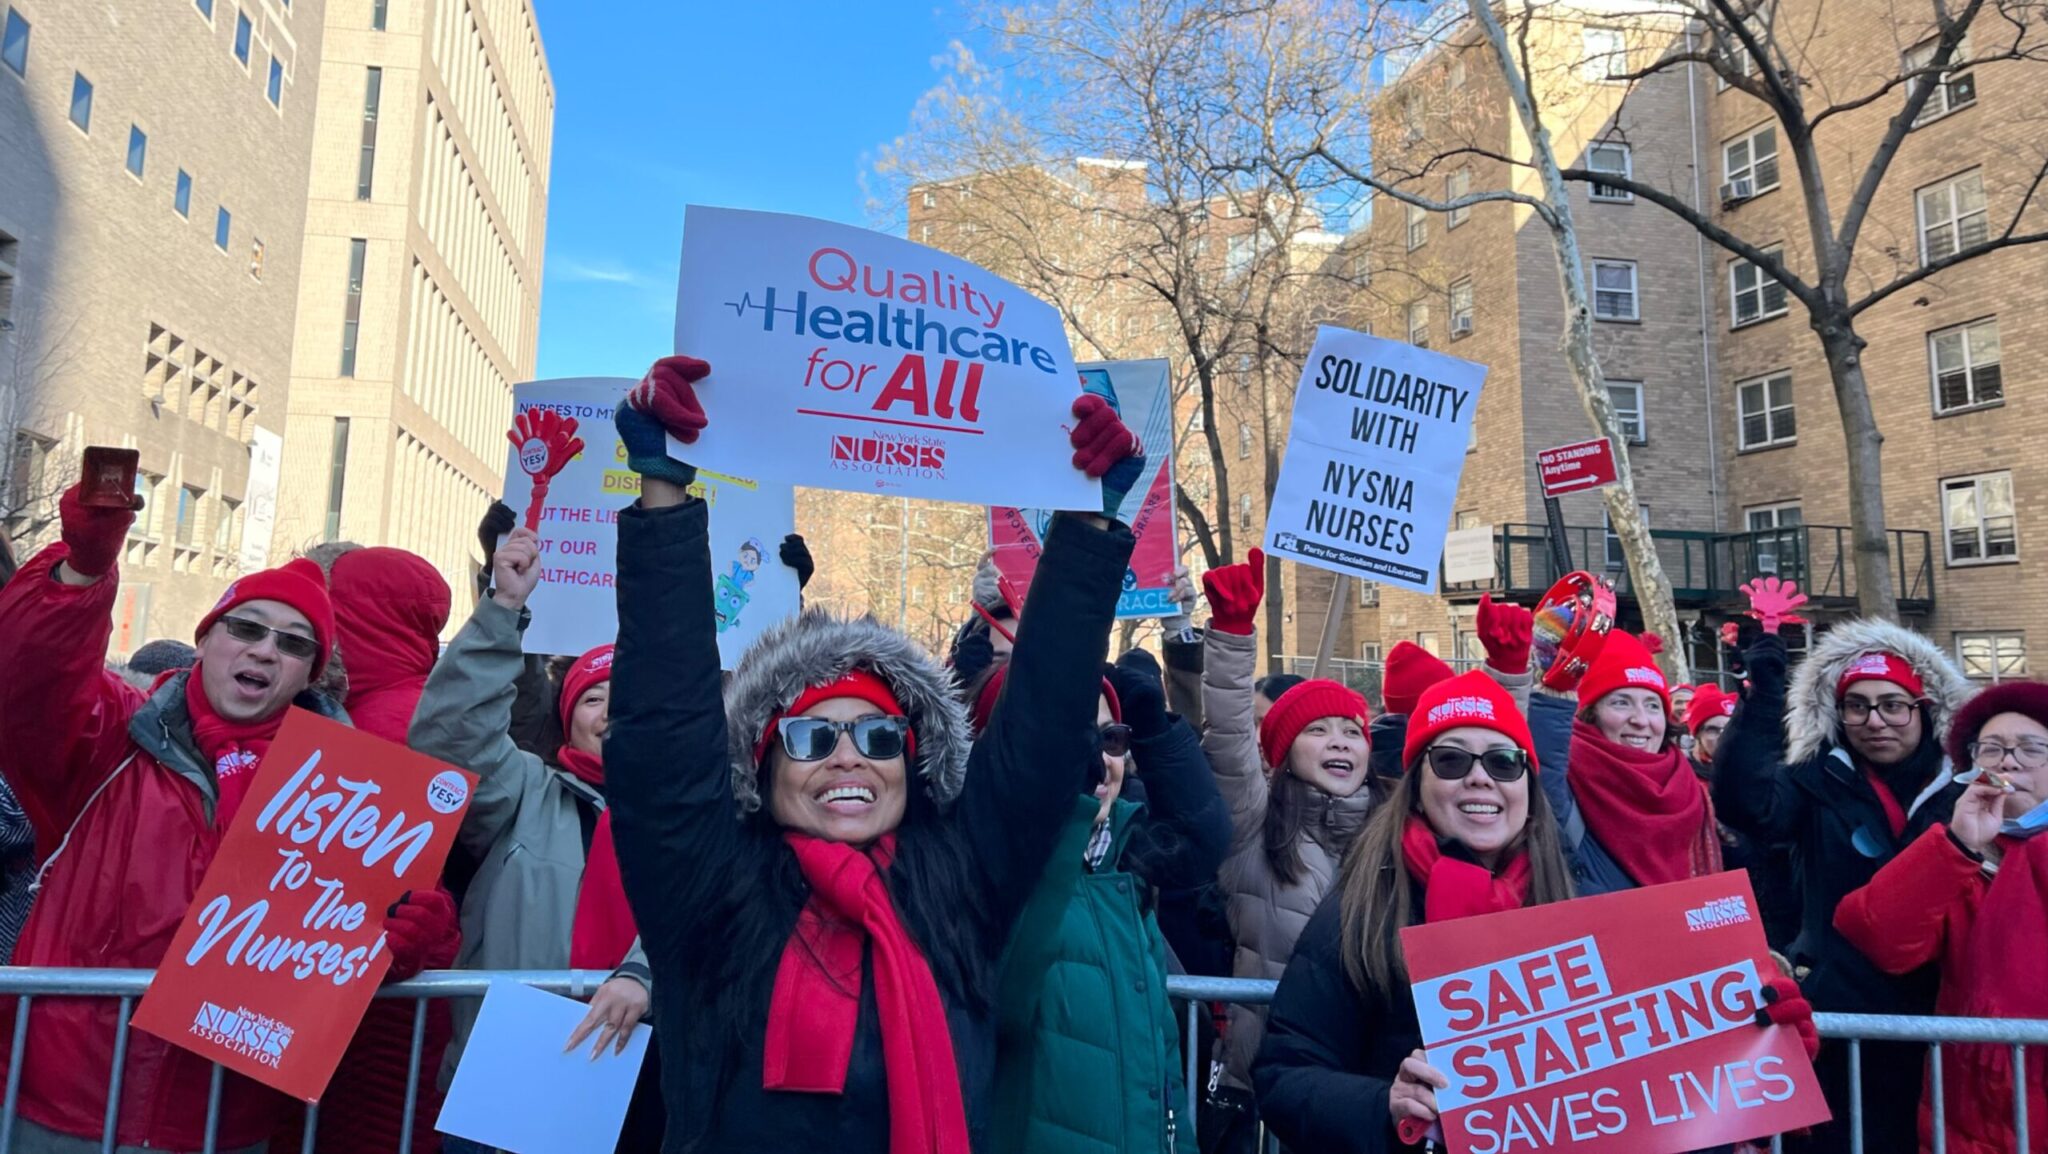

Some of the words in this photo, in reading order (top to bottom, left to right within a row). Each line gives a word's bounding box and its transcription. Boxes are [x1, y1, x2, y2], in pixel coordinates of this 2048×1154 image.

[808, 247, 1005, 329] Quality
[763, 286, 1058, 374] Healthcare
[804, 347, 878, 392] for
[871, 354, 985, 422] All
[1315, 354, 1469, 423] SOLIDARITY
[575, 406, 593, 418] TO
[1351, 406, 1419, 454] WITH
[831, 435, 946, 469] NURSES
[872, 430, 896, 441] New
[898, 433, 920, 444] York
[922, 436, 946, 447] State
[1541, 454, 1555, 465] NO
[1556, 445, 1601, 462] STANDING
[523, 454, 541, 467] YES
[830, 460, 945, 480] ASSOCIATION
[1545, 461, 1581, 475] Anytime
[1322, 460, 1414, 513] NYSNA
[560, 508, 592, 522] THE
[1004, 510, 1040, 560] ROTECT
[1305, 499, 1414, 555] NURSES
[560, 541, 597, 556] OUR
[1303, 544, 1325, 557] Party
[1325, 548, 1338, 559] for
[1338, 553, 1373, 568] Socialism
[1373, 562, 1387, 572] and
[1387, 564, 1422, 580] Liberation
[430, 783, 454, 804] YES
[269, 849, 311, 891] To
[303, 877, 365, 931] The
[1685, 898, 1747, 926] NURSES
[1689, 914, 1752, 932] ASSOCIATION
[186, 894, 388, 985] Nurses!
[1439, 944, 1601, 1032] SAFE
[194, 1001, 293, 1057] NURSES
[236, 1005, 257, 1021] New
[258, 1013, 274, 1029] York
[1452, 970, 1758, 1099] STAFFING
[189, 1024, 281, 1069] ASSOCIATION
[1464, 1087, 1628, 1154] SAVES
[1641, 1056, 1796, 1126] LIVES
